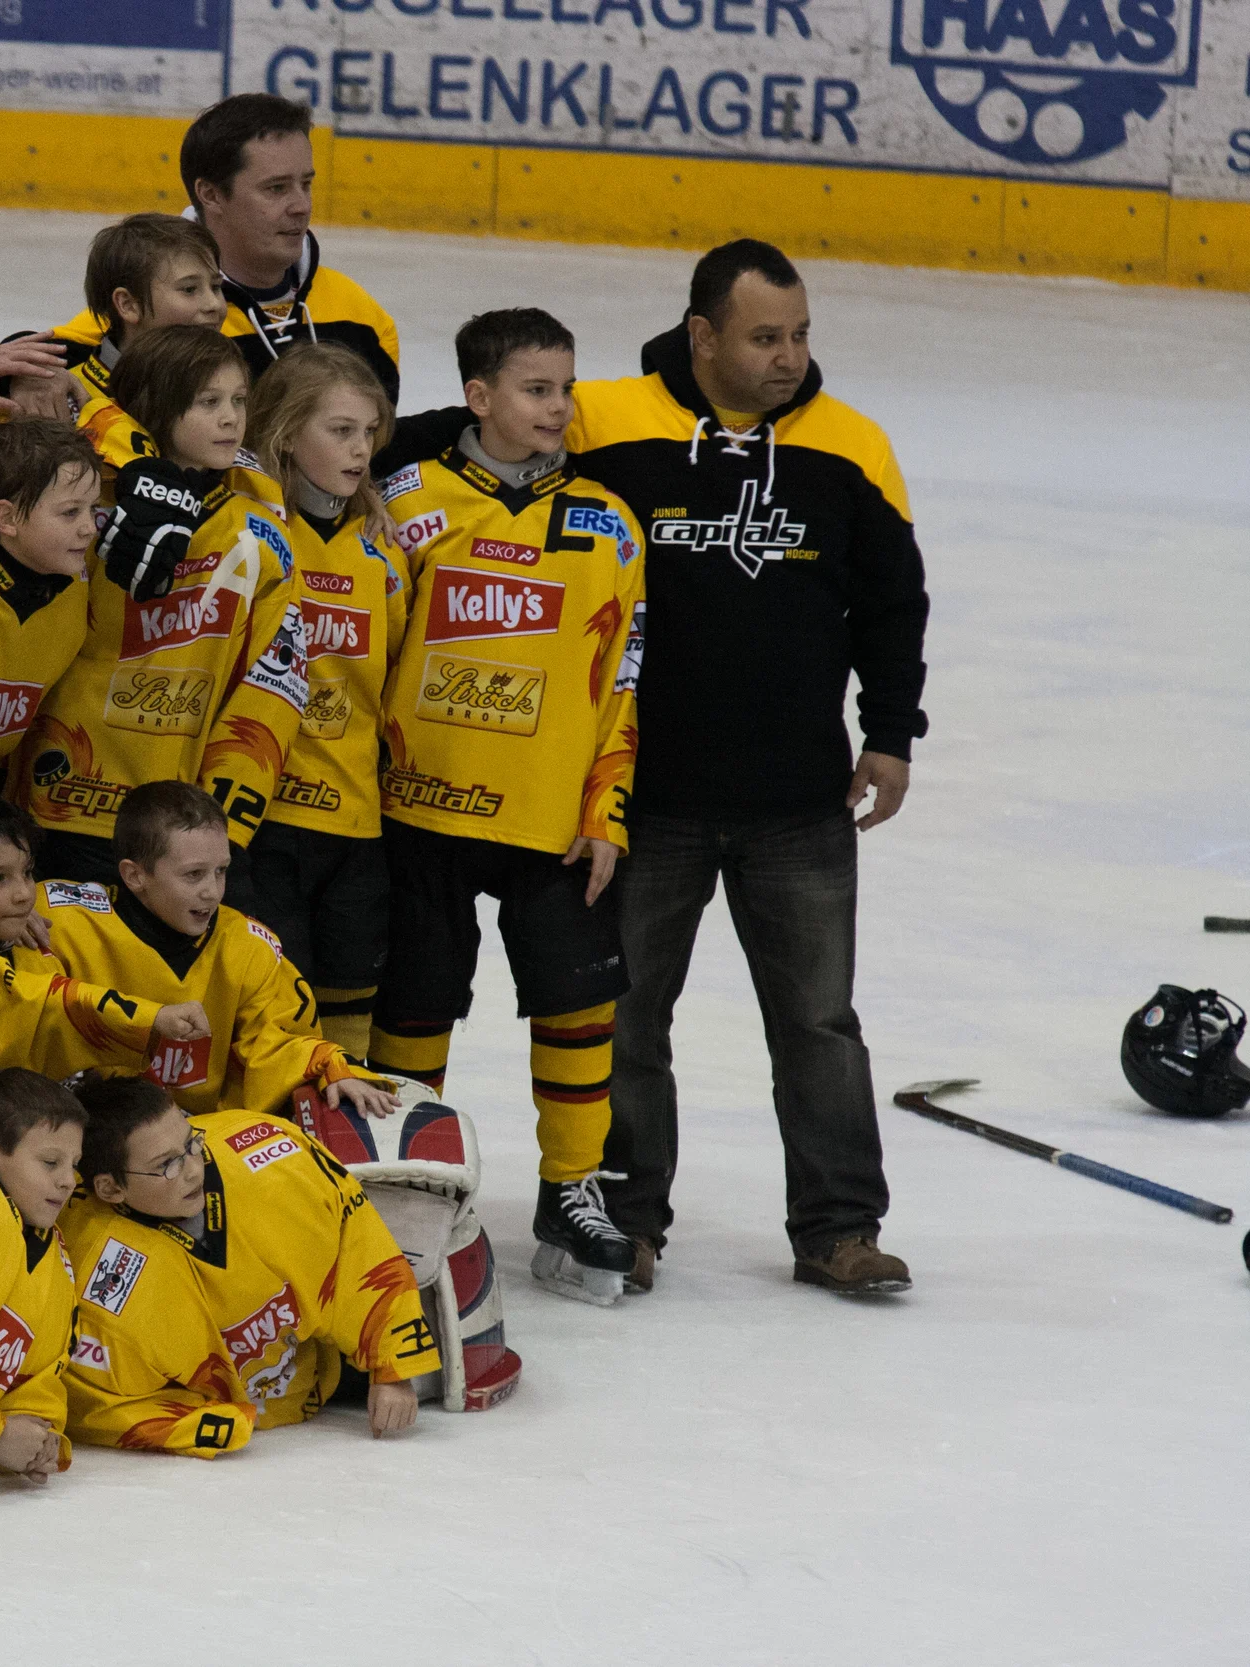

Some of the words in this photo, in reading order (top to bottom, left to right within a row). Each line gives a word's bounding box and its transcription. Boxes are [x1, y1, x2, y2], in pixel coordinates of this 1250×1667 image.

[922, 0, 1178, 64] HAAS
[266, 45, 860, 145] GELENKLAGER
[133, 475, 202, 519] Reebo
[652, 508, 687, 518] JUNIOR
[399, 515, 444, 551] COH
[475, 541, 516, 560] ASKÖ
[785, 548, 820, 560] HOCKEY
[140, 597, 220, 642] Kellys
[447, 584, 544, 629] Kelly's
[304, 613, 359, 651] elly's
[423, 662, 540, 716] Ströck
[138, 714, 180, 728] BRT
[447, 706, 506, 725] BROT
[50, 783, 127, 814] capi
[206, 776, 267, 832] 12
[278, 775, 341, 812] itals
[382, 770, 501, 815] capitals
[234, 1125, 270, 1150] ASKÖ
[229, 1301, 296, 1355] elly's
